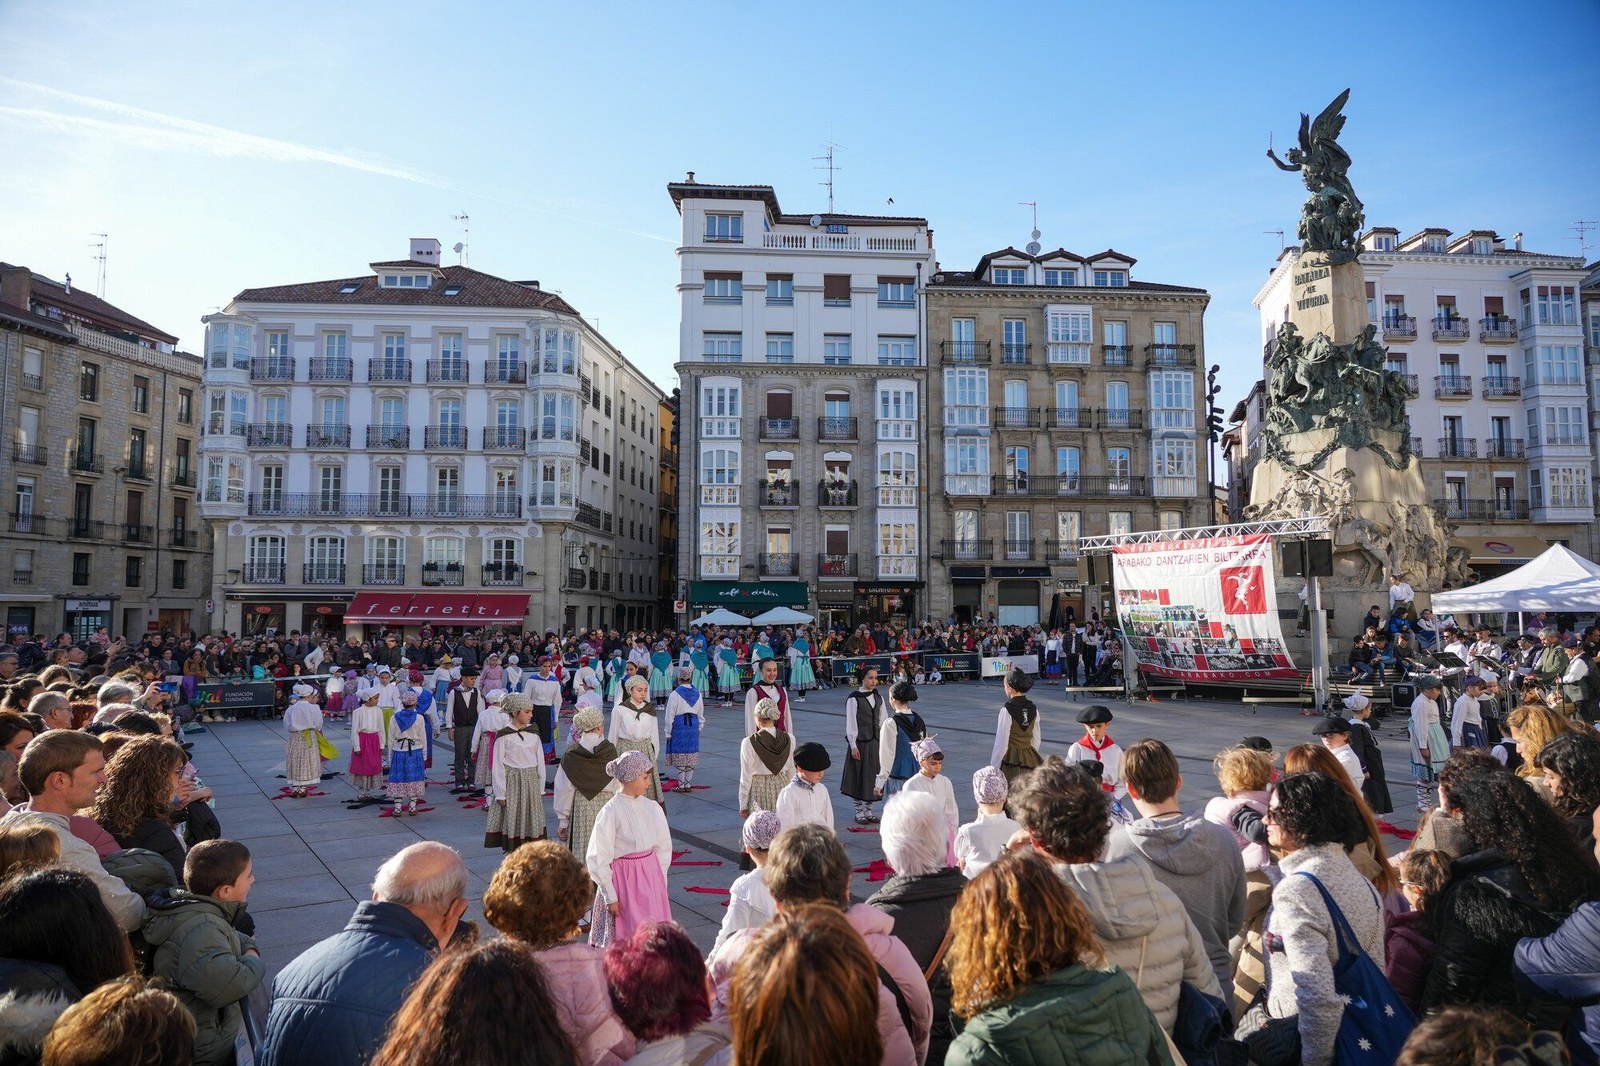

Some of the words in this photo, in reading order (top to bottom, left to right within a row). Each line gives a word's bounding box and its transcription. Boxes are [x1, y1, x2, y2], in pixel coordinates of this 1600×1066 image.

[1297, 294, 1329, 310] VITORIA
[1117, 557, 1152, 568] ARABAKO
[1156, 553, 1209, 566] DANTZARIEN
[367, 603, 500, 616] ferretti
[934, 658, 955, 669] Vital
[992, 661, 1013, 673] Vital
